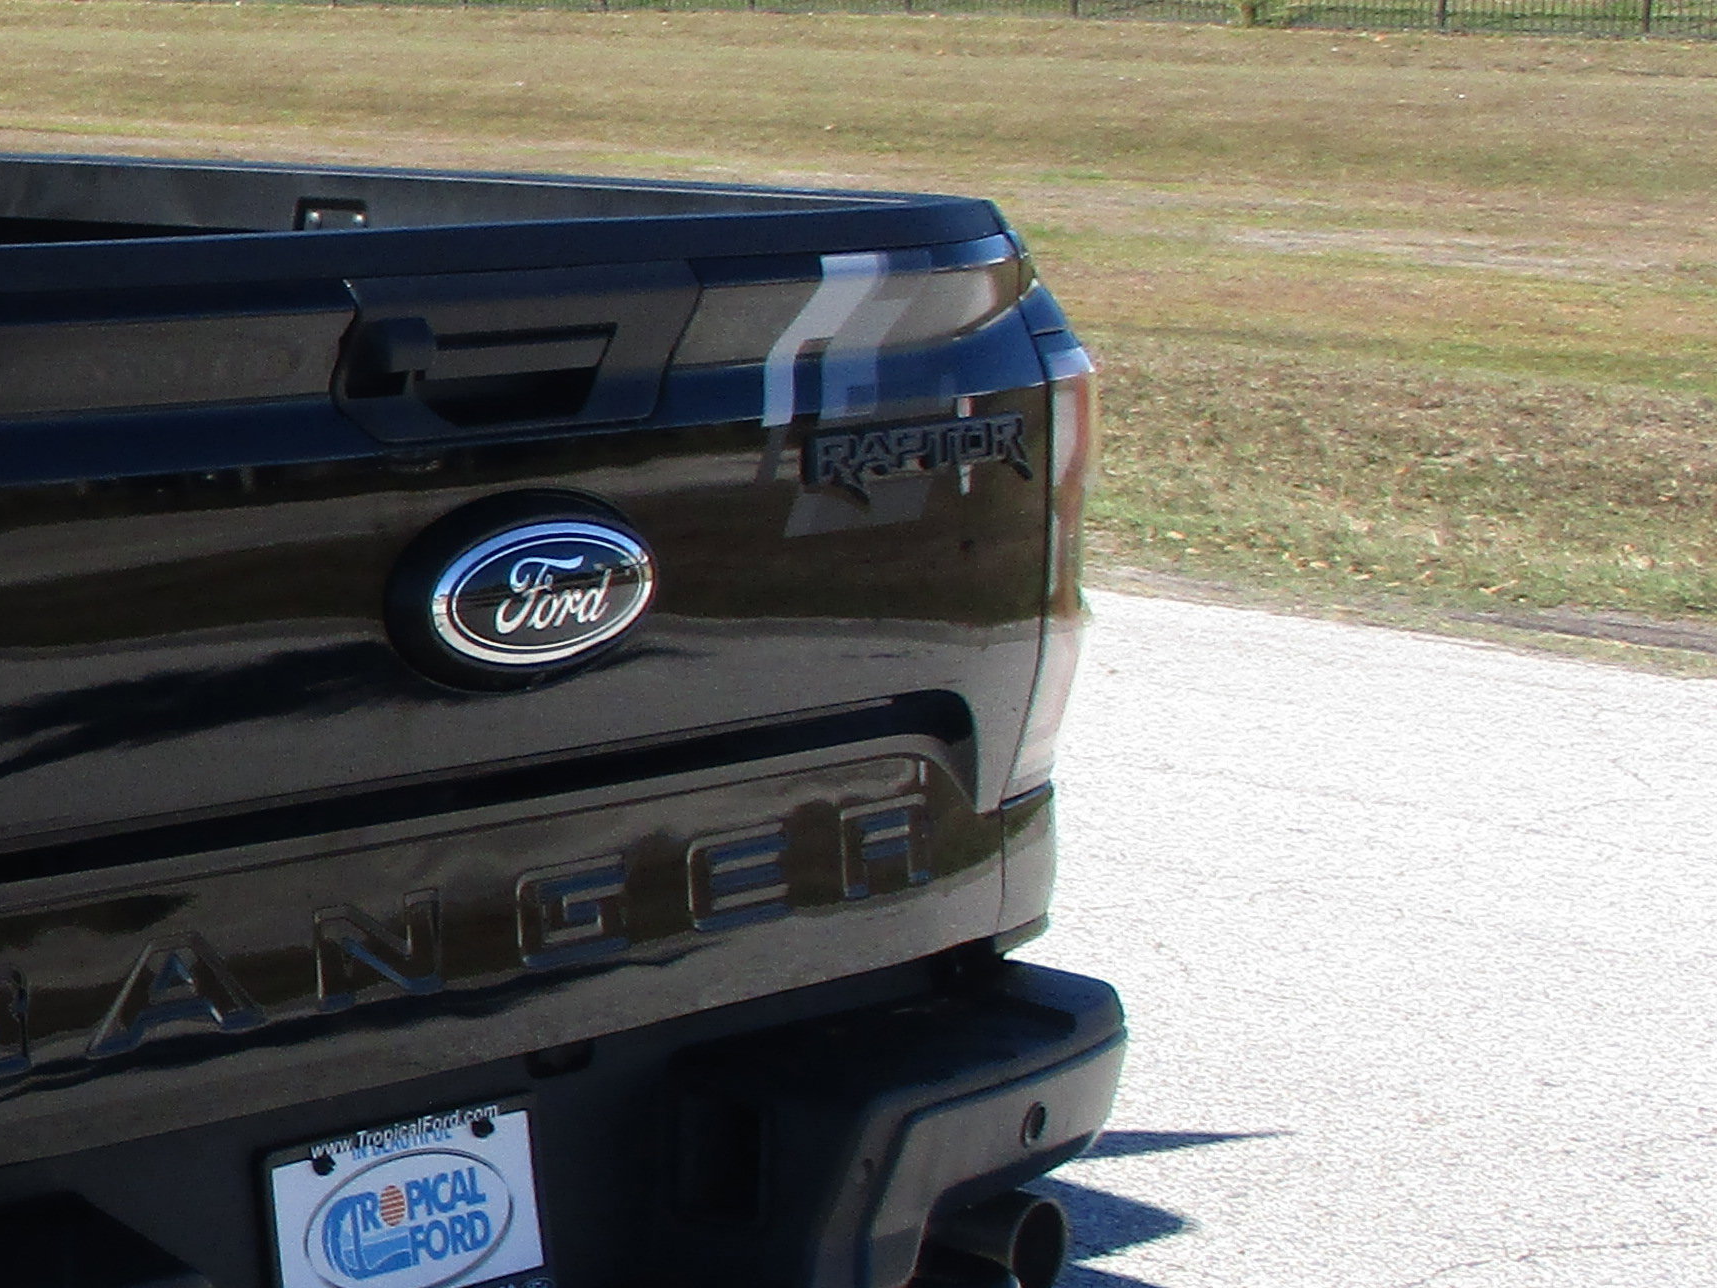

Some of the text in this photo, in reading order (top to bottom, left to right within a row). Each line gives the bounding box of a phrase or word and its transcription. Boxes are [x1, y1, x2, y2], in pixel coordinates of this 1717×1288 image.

[804, 413, 1033, 501] RAPTOR
[495, 555, 613, 635] Ford
[310, 1103, 498, 1159] www.TropicalFord.com
[322, 1166, 488, 1269] TROPICAL
[409, 1209, 491, 1266] FORD
